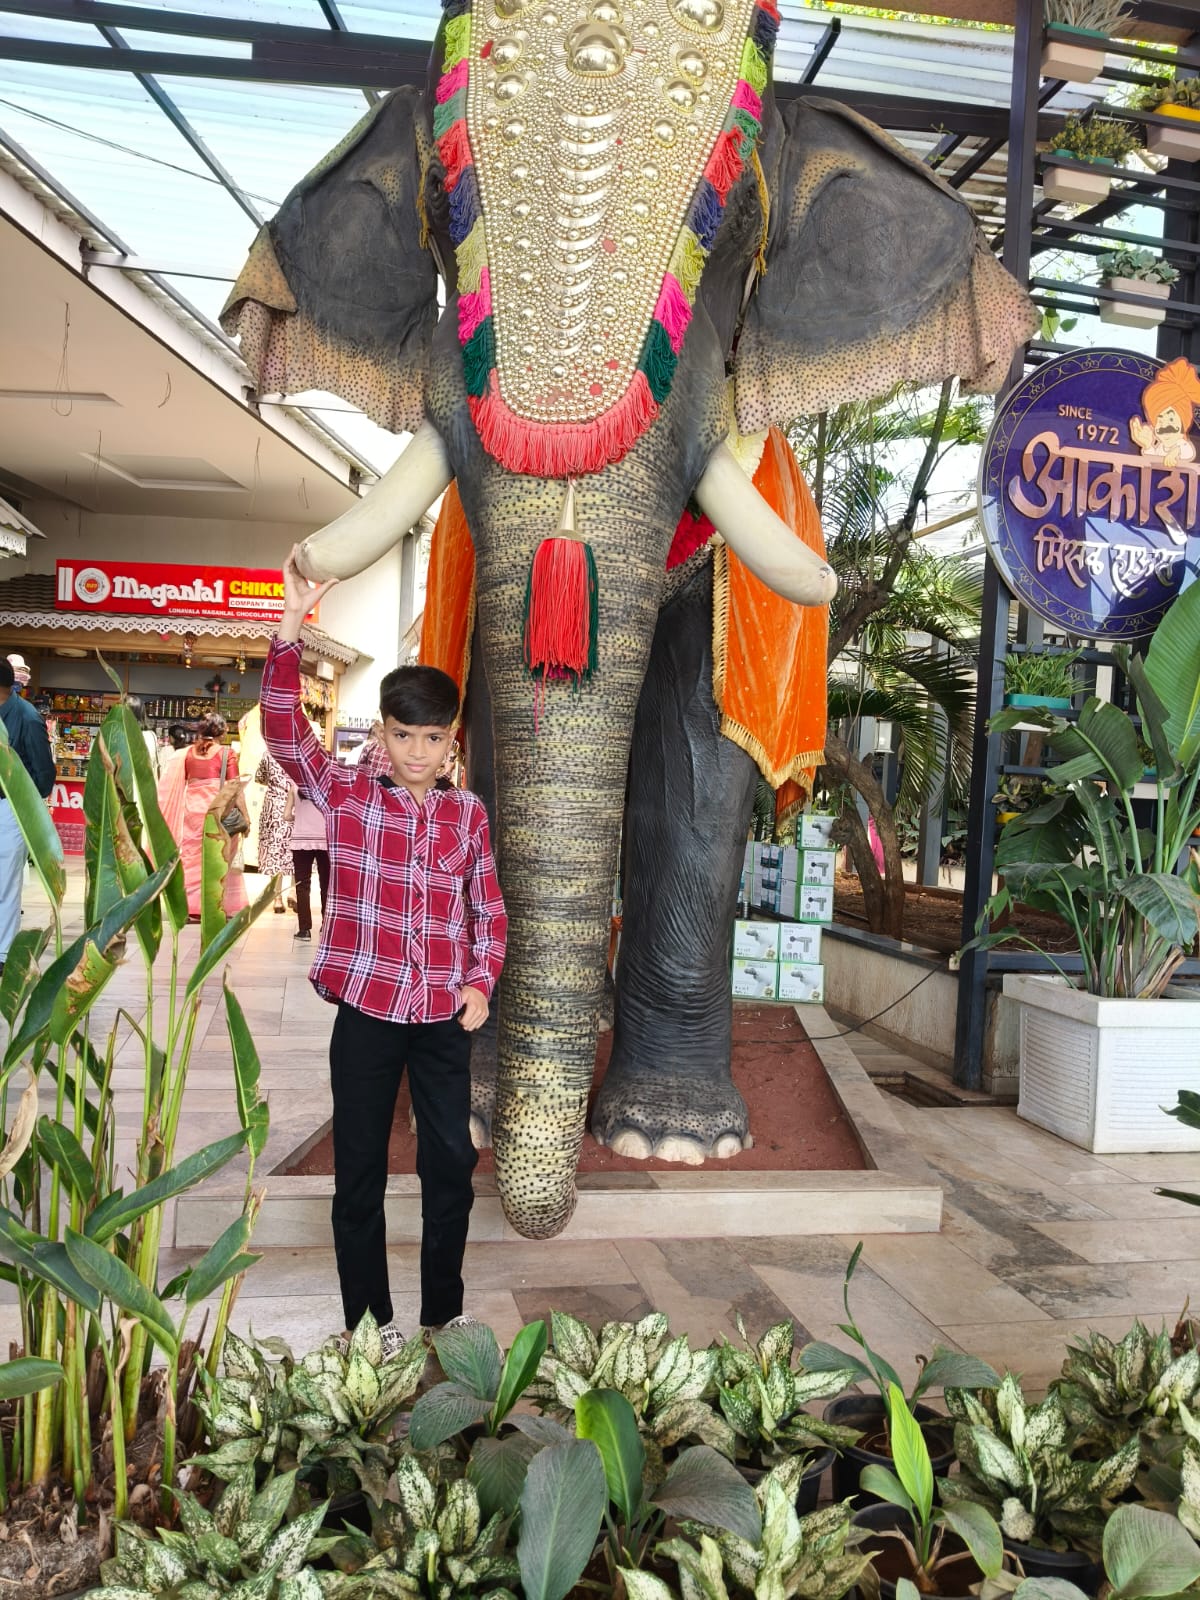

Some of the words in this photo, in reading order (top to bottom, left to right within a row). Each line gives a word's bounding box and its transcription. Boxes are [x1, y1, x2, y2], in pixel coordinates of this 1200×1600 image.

[1058, 404, 1093, 420] SINCE
[1076, 423, 1120, 445] 1972
[1008, 431, 1200, 546] आकाश
[112, 575, 224, 607] Maganlal
[229, 580, 285, 597] CHIKK
